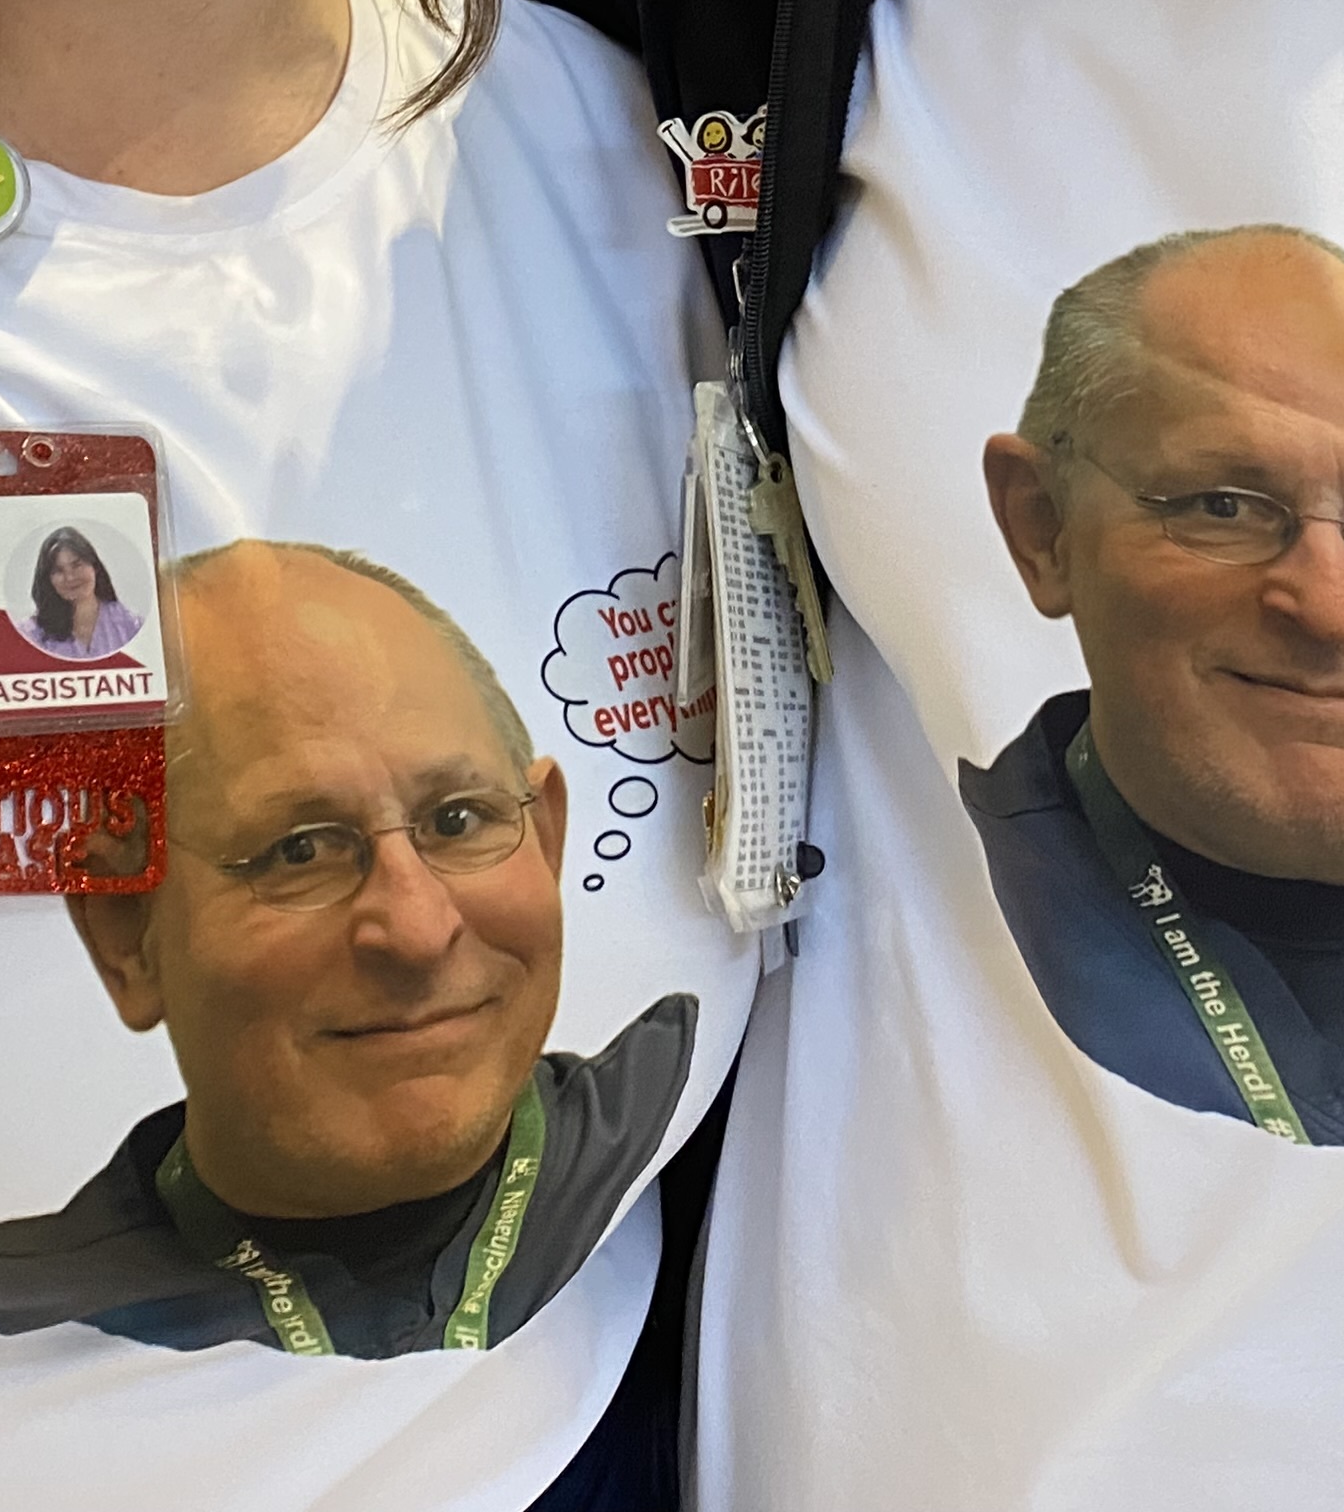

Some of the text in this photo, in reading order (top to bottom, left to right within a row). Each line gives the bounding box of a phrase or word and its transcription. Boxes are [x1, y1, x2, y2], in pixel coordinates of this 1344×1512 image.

[597, 606, 654, 639] You
[607, 632, 676, 691] prop
[1155, 913, 1182, 925] I
[1163, 928, 1201, 967] am
[1189, 970, 1227, 1018] the
